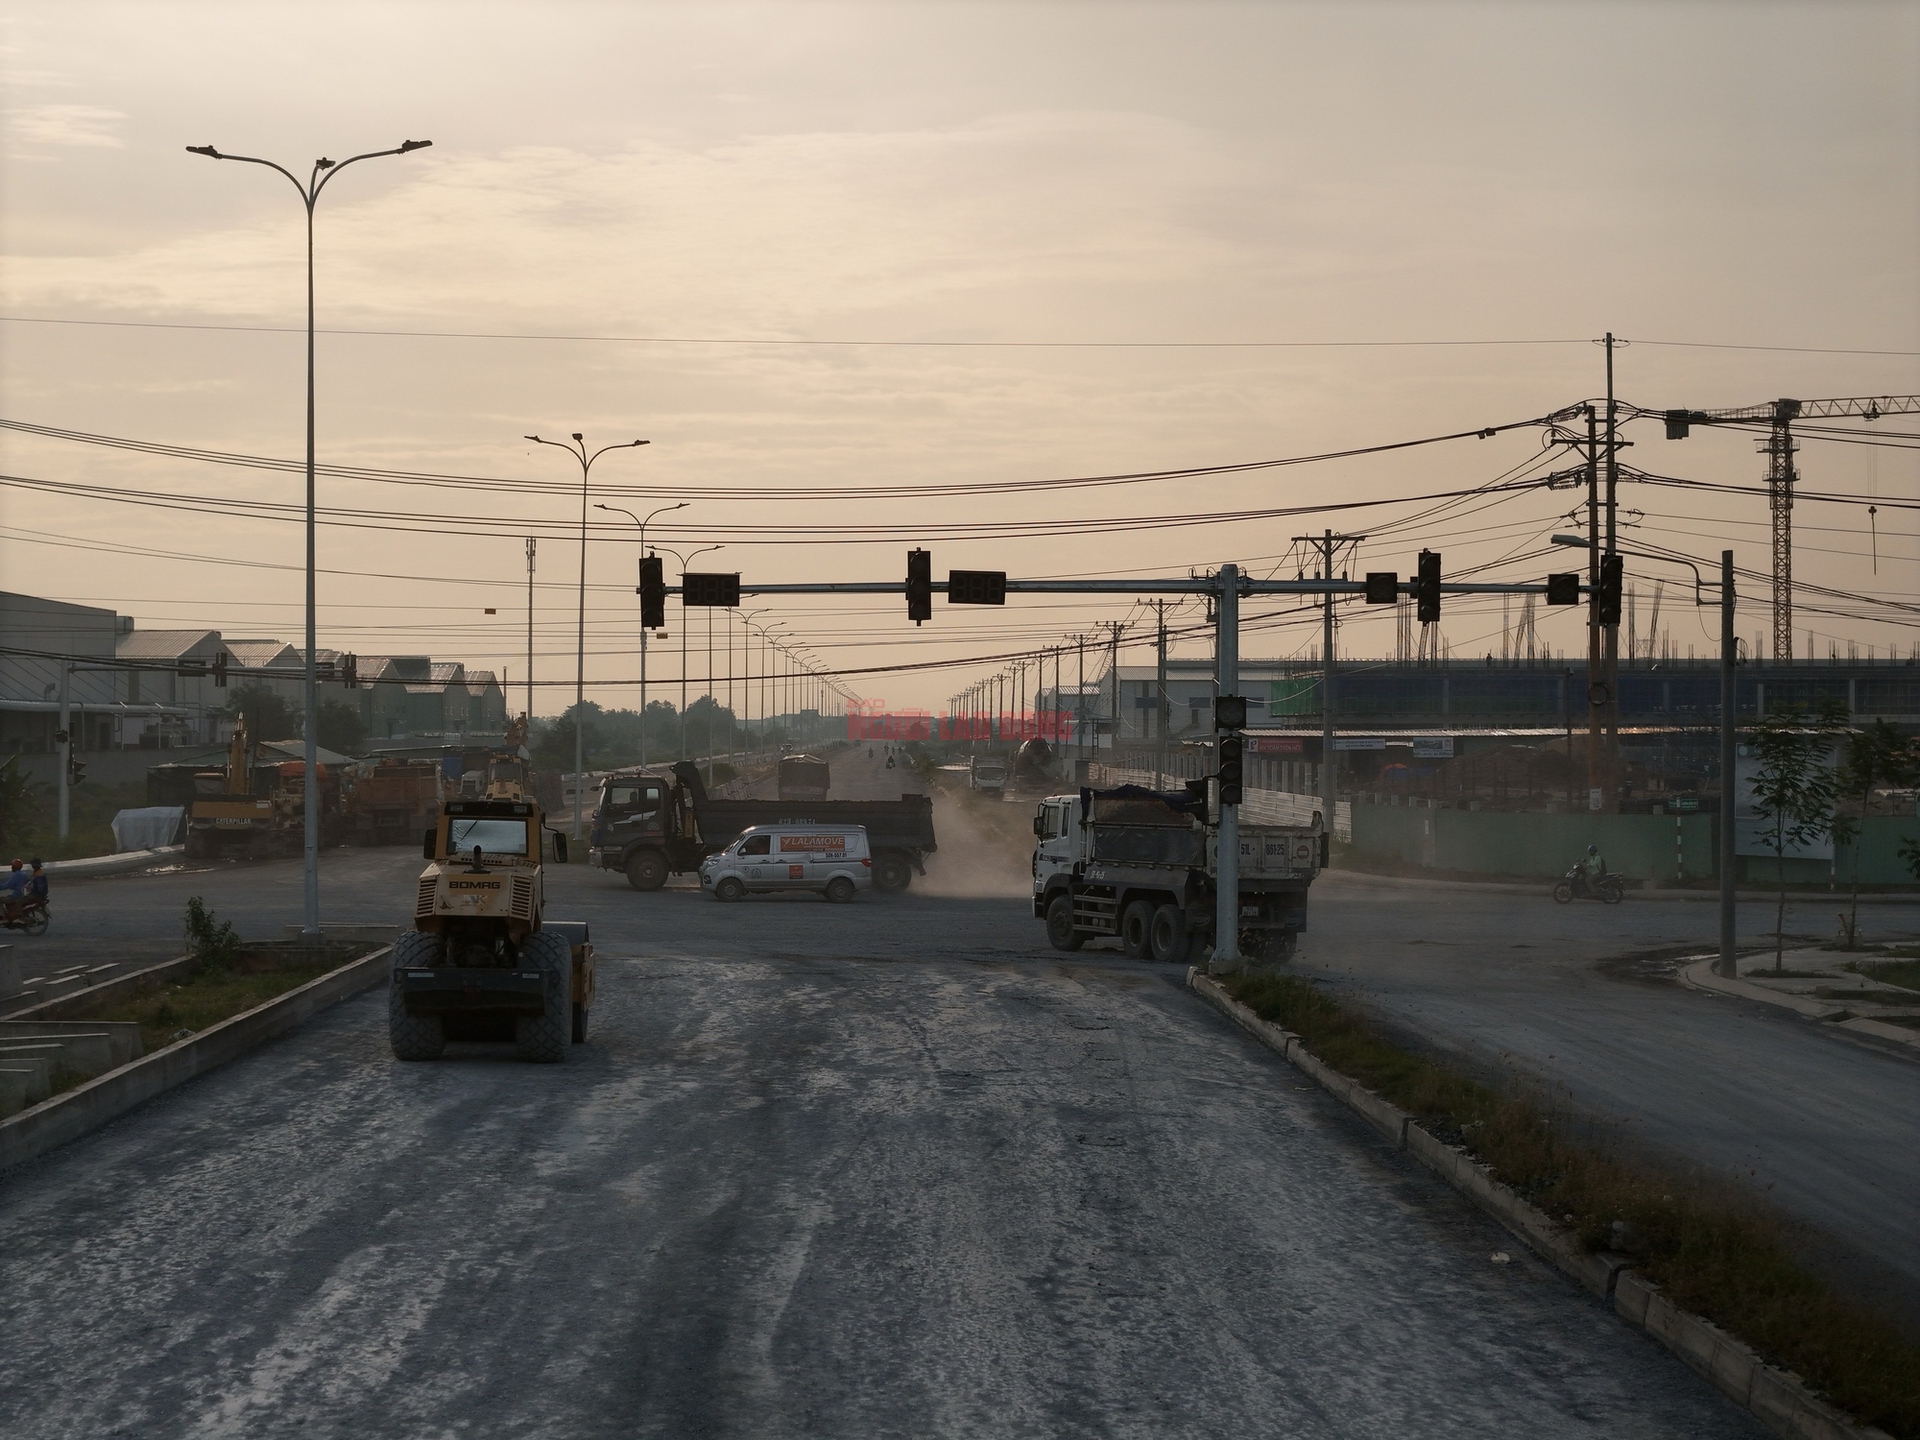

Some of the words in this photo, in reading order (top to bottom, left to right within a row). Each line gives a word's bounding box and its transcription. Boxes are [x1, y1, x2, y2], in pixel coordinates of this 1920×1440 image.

[215, 817, 252, 825] CATERPILLAR
[791, 837, 844, 846] LALAMOVE
[448, 881, 501, 889] BOMAG
